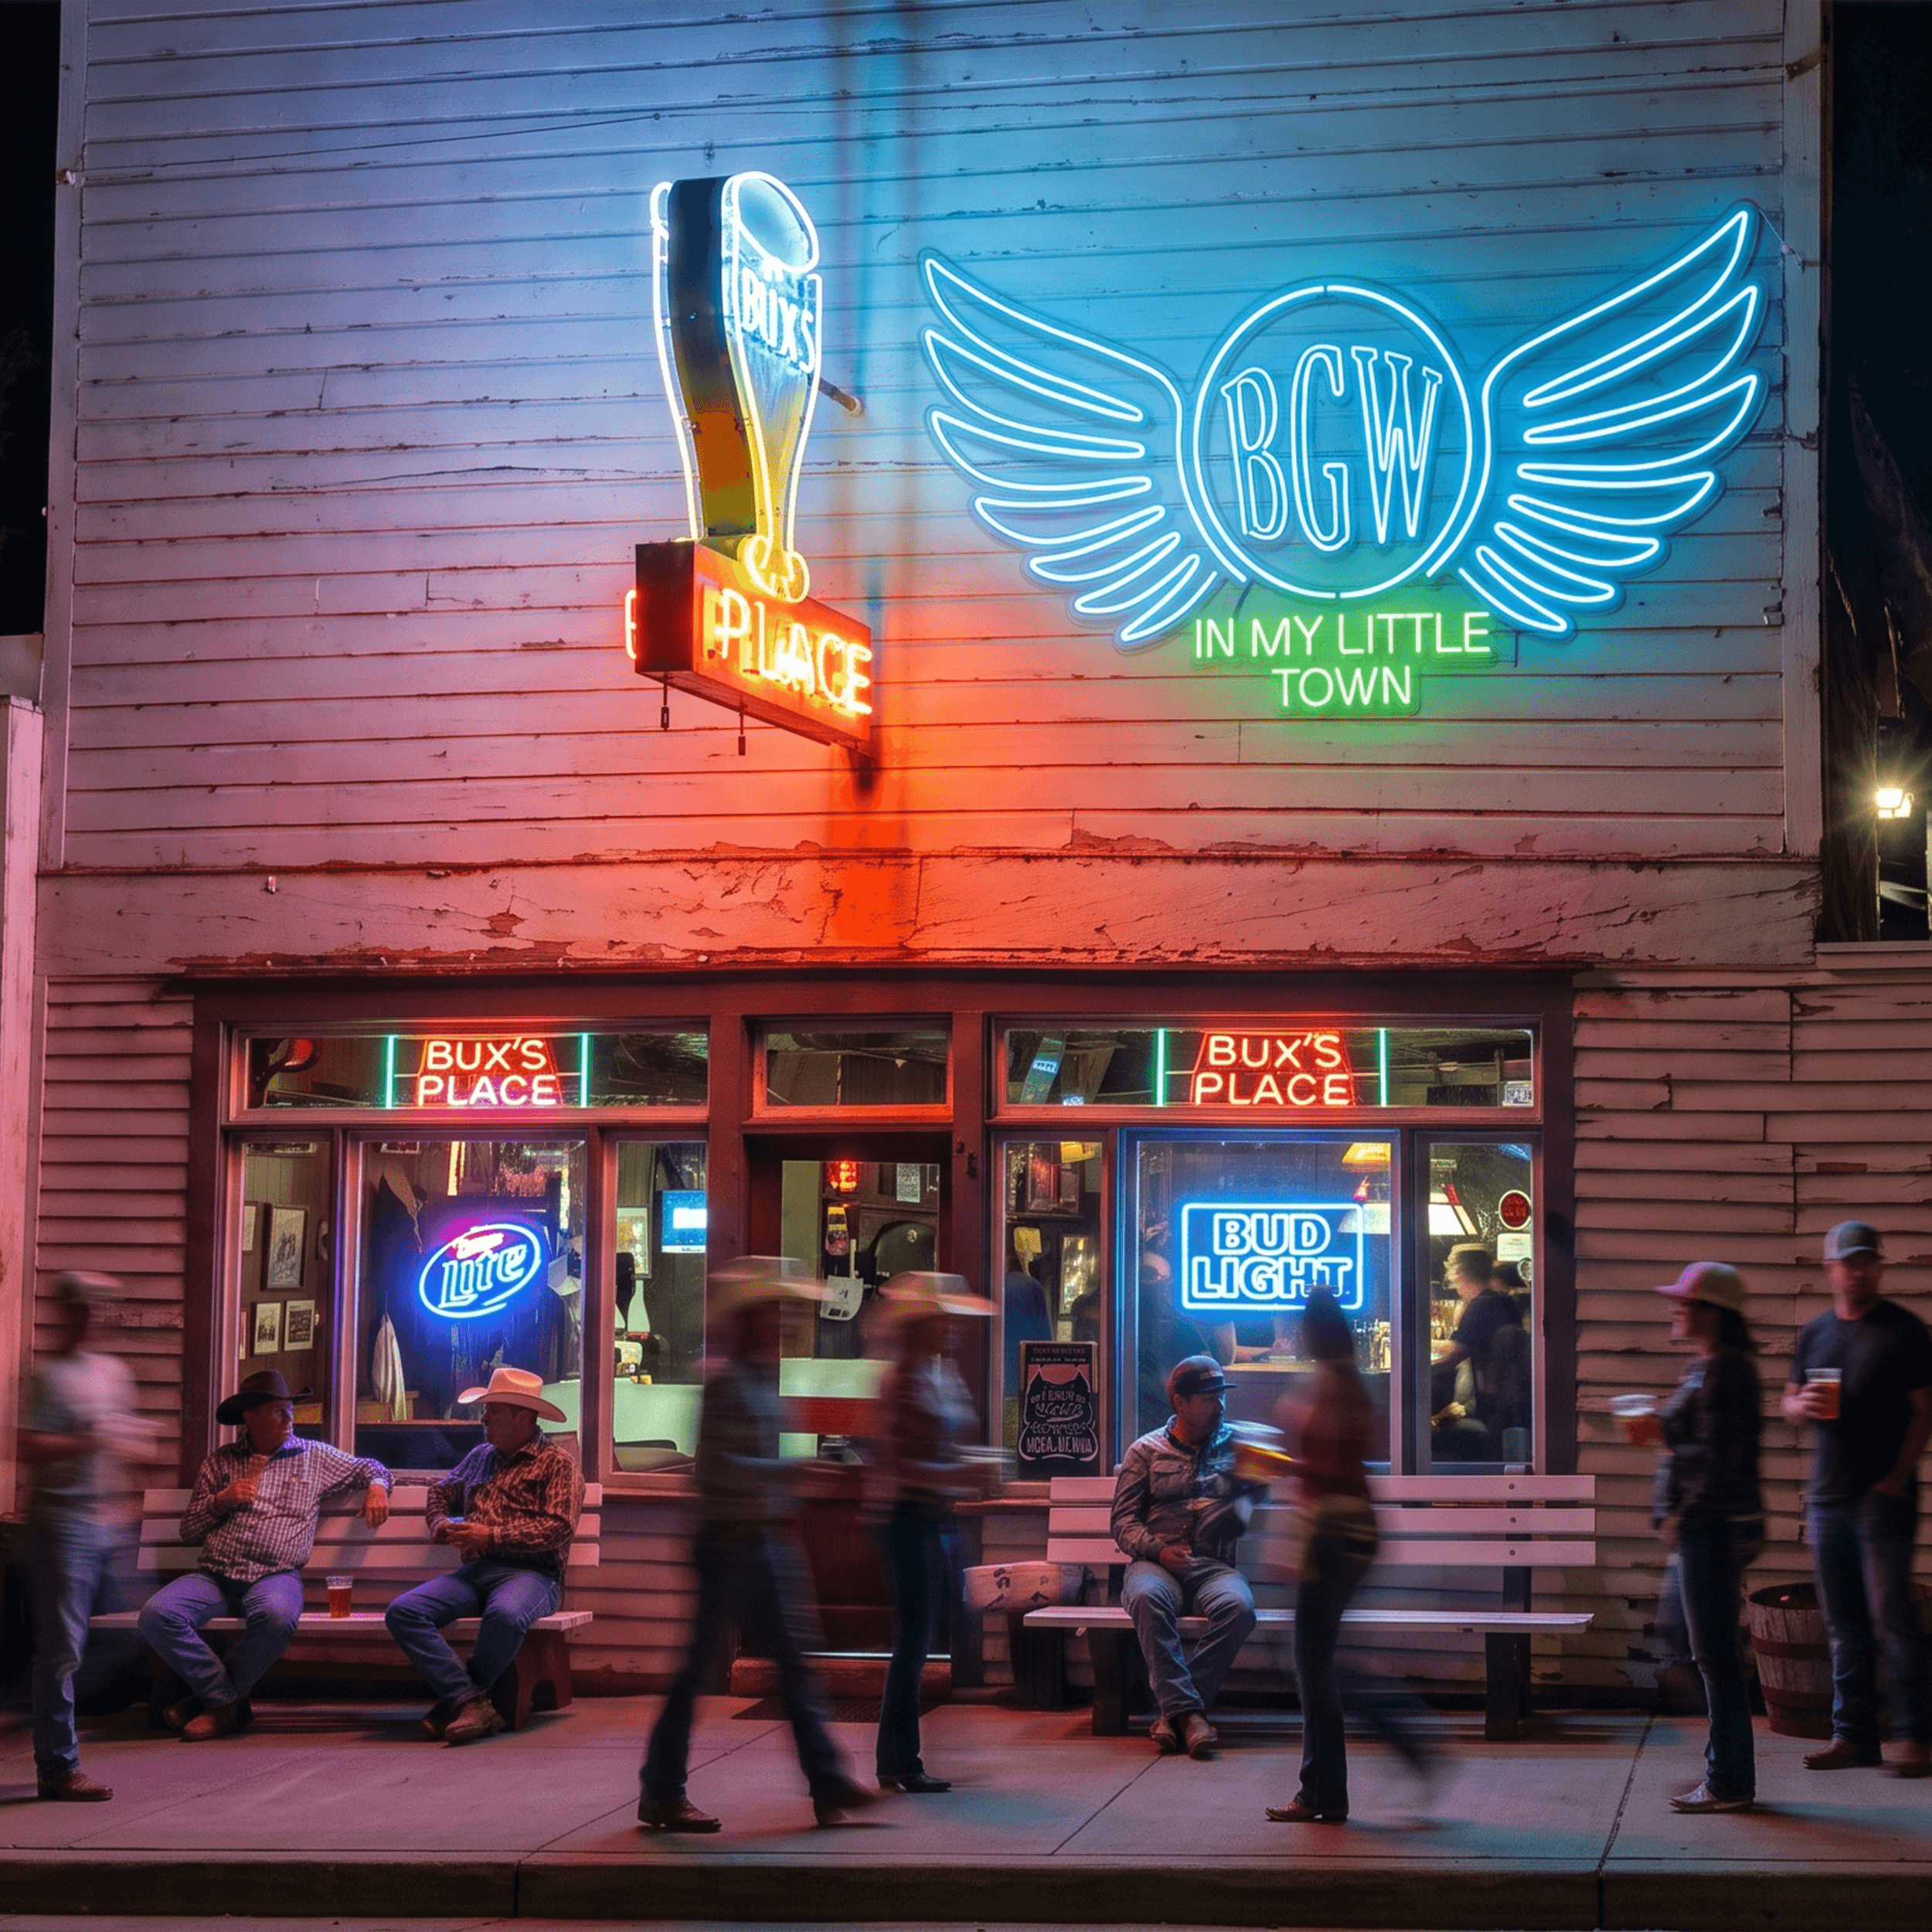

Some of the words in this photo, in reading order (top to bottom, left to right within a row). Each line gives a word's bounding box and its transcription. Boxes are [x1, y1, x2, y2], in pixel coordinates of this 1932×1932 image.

[1220, 344, 1442, 552] BGW
[709, 587, 872, 715] PLACE
[1196, 617, 1234, 658] IN
[1251, 614, 1324, 657] MY
[1338, 611, 1491, 655] LITTLE
[1271, 664, 1411, 707] TOWN
[427, 1036, 546, 1070] BUX'S
[1209, 1032, 1342, 1068] BUX'S
[418, 1075, 557, 1107] PLACE
[1195, 1072, 1349, 1105] PLACE
[1213, 1213, 1331, 1256] BUD
[1192, 1255, 1353, 1300] LIGHT
